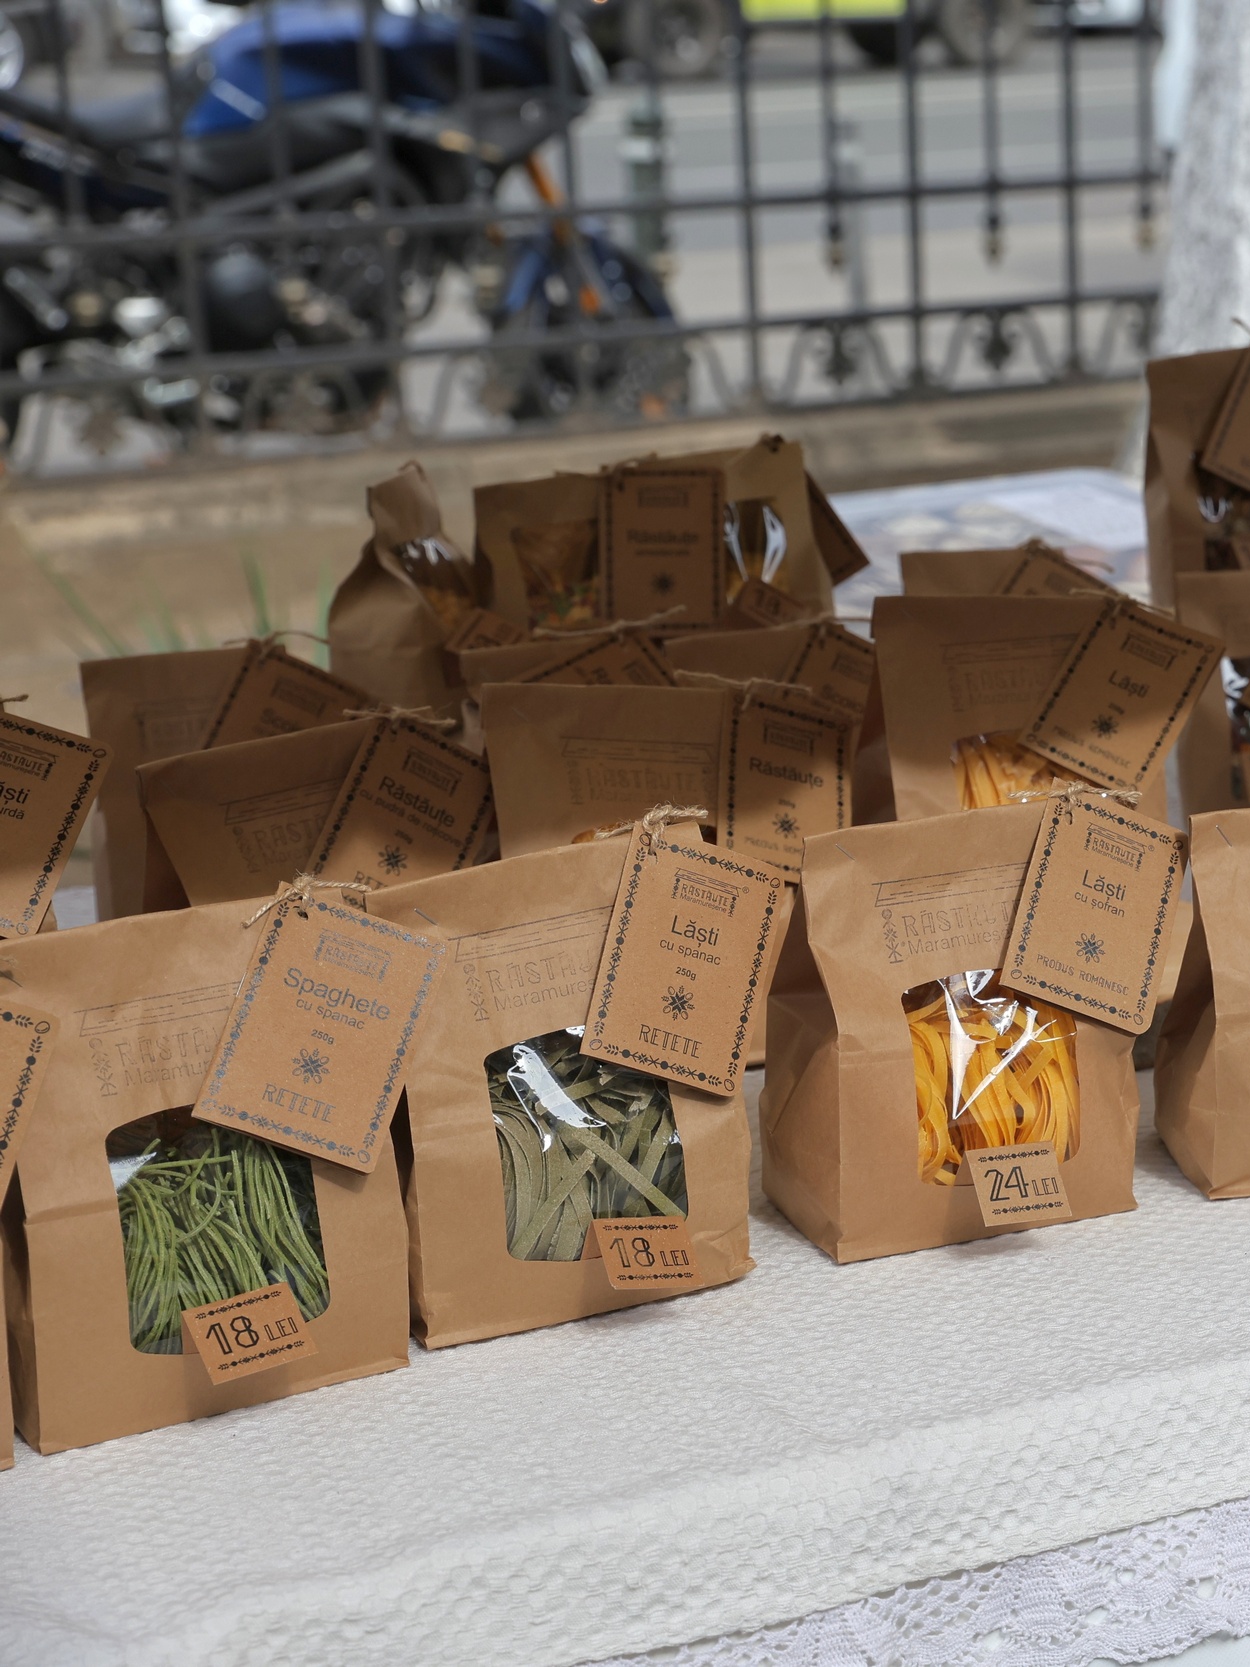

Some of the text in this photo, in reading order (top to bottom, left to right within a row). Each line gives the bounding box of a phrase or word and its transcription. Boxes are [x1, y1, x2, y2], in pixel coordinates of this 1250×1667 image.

[1081, 870, 1126, 902] Lăști
[1074, 892, 1125, 918] cu șofran
[671, 915, 720, 948] Lăști
[659, 938, 722, 966] cu spanac
[676, 966, 697, 981] 250g
[1037, 954, 1130, 996] PRODUS ROMÂNESC
[284, 967, 390, 1021] Spaghete
[296, 999, 365, 1030] cu spanac
[311, 1029, 335, 1045] 250g
[984, 1166, 1059, 1201] 24 LEI
[610, 1237, 689, 1268] 18 LEI
[206, 1316, 298, 1355] 18 LEI
